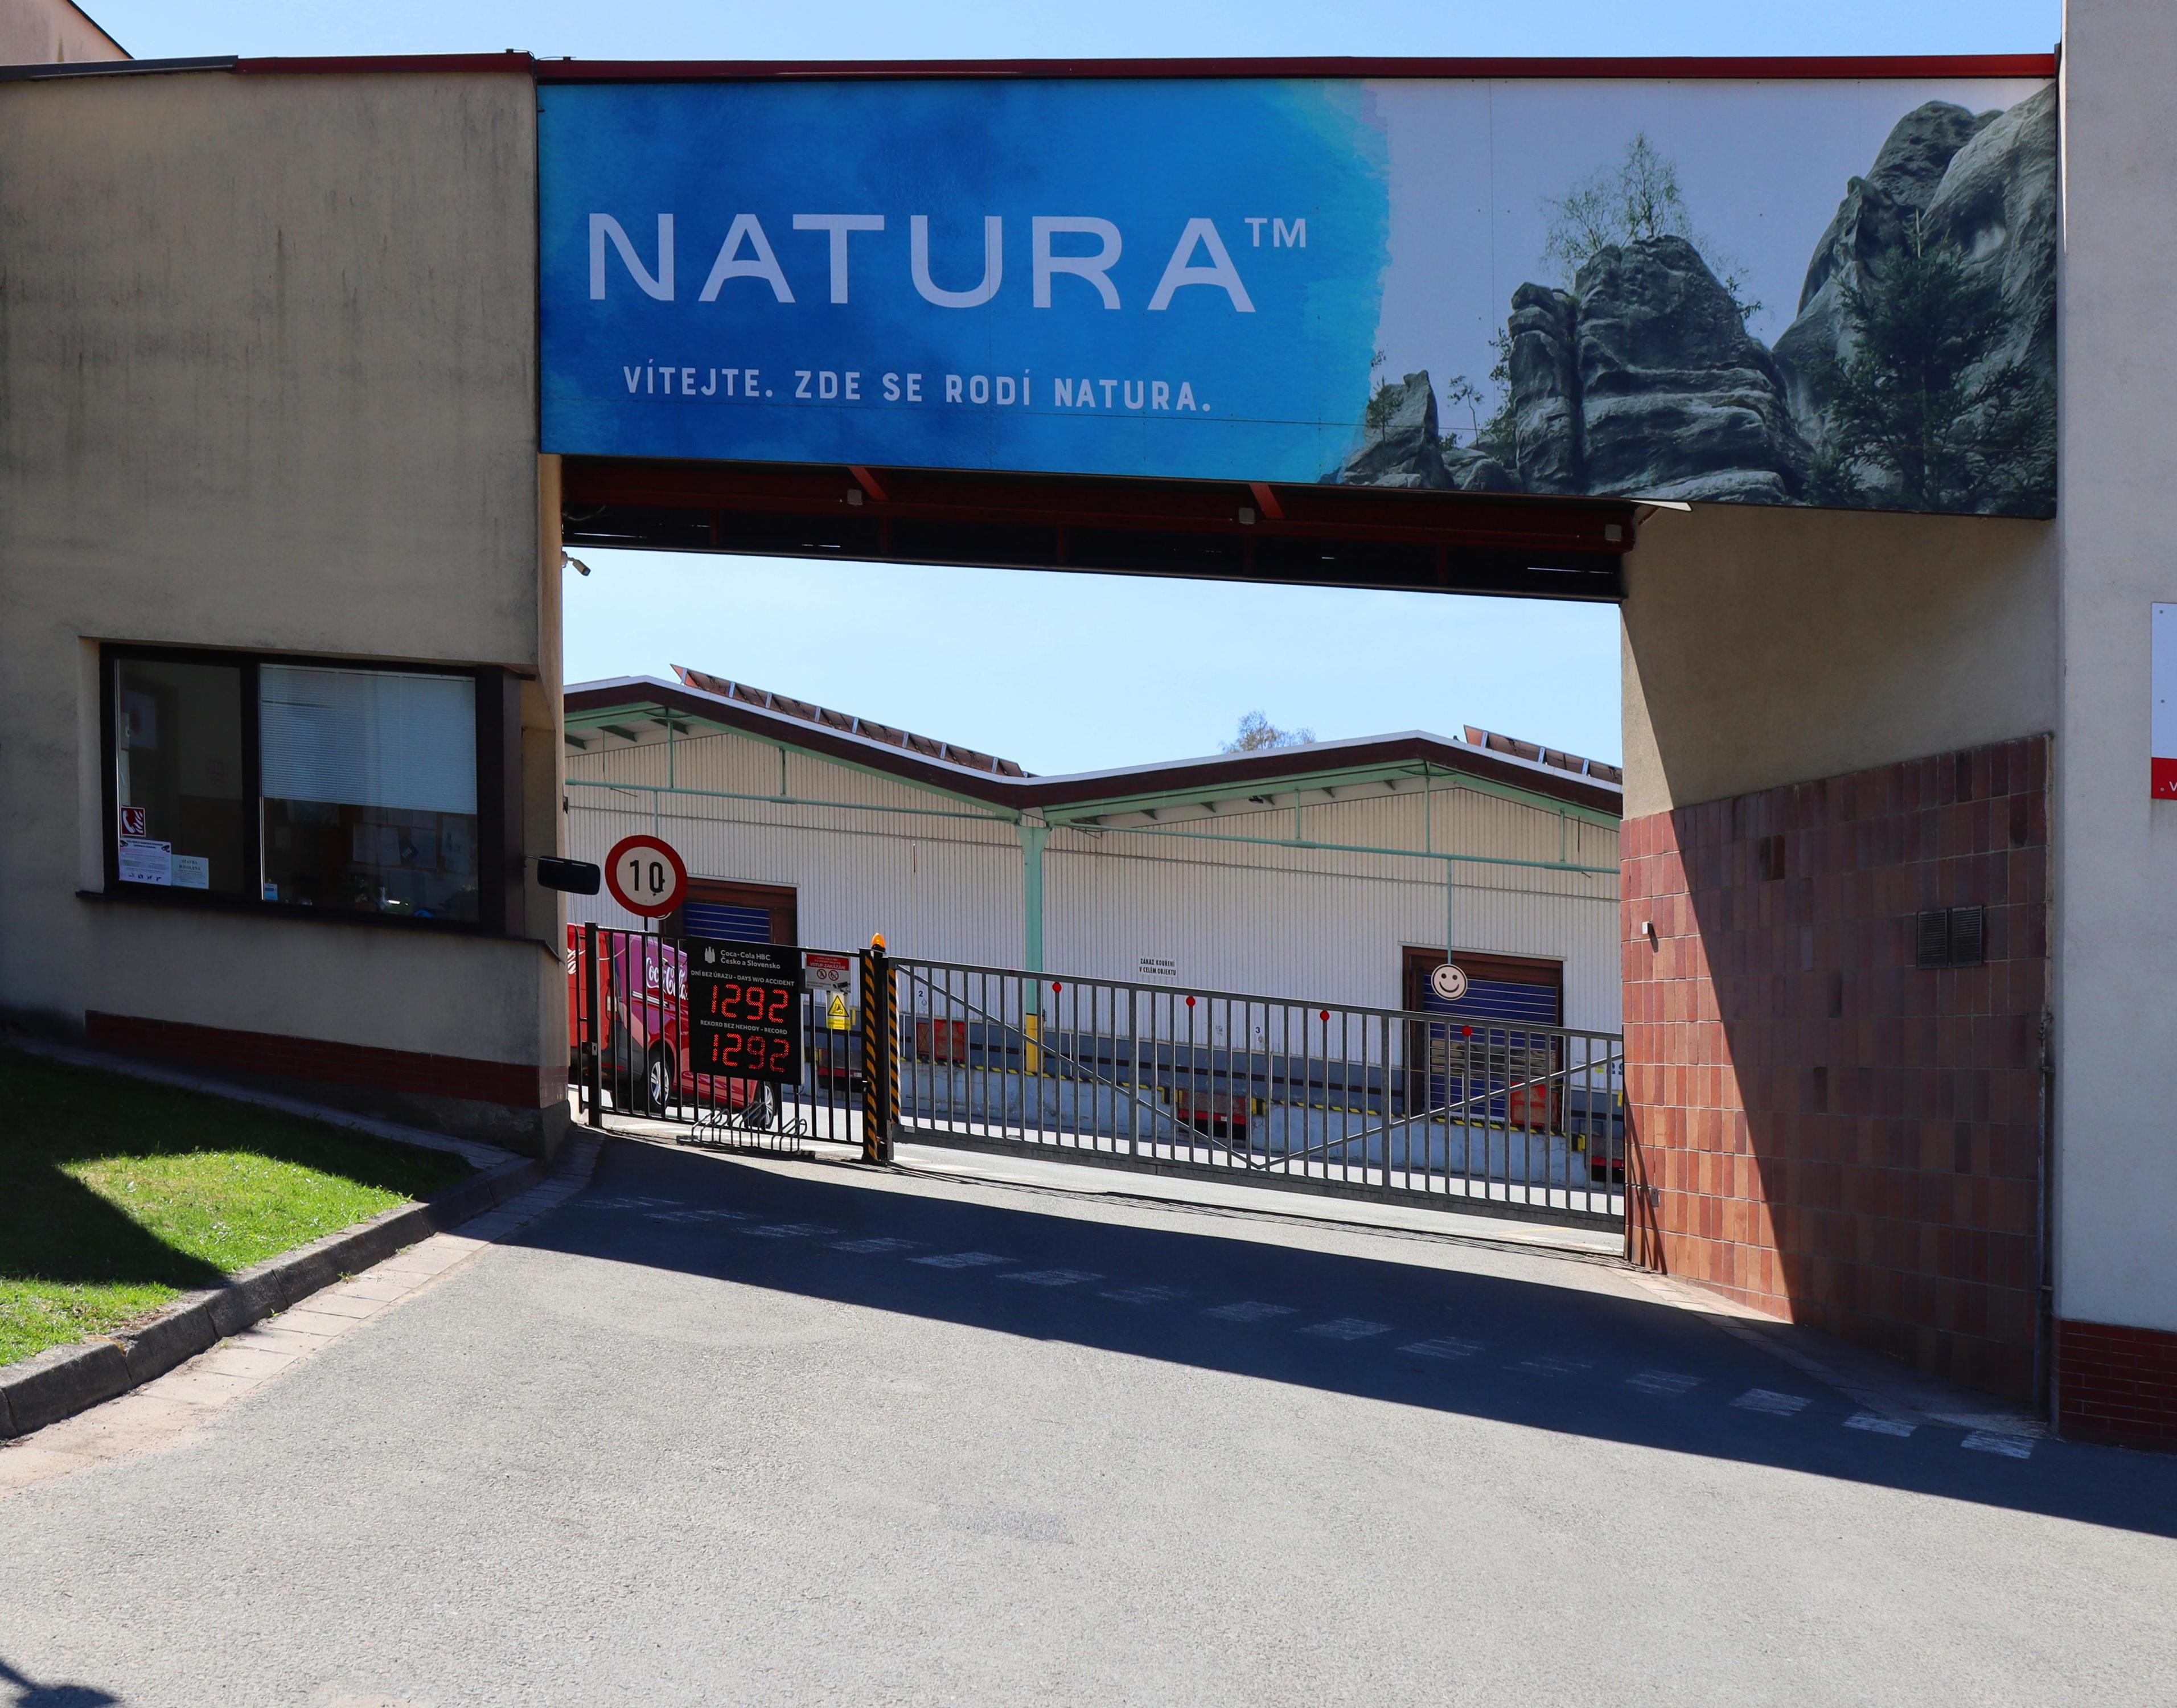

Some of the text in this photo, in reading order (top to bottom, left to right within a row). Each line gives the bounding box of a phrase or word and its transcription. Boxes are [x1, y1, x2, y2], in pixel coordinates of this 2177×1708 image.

[589, 213, 1256, 313] NATURA
[623, 358, 1211, 412] VÍTEJTE. ZDE SE RODÍ NATURA.
[629, 860, 663, 893] 10
[720, 950, 771, 961] Coca-Cola HBC
[720, 956, 741, 966] Česko
[747, 960, 781, 970] Slovensko
[1140, 957, 1175, 967] ZÁKAZ KOUŘENÍ
[713, 971, 733, 979] ÚRAZU
[765, 978, 795, 987] ACCIDENT
[711, 984, 788, 1023] 1292
[736, 1024, 759, 1032] NEHODY
[712, 1033, 790, 1073] 1292
